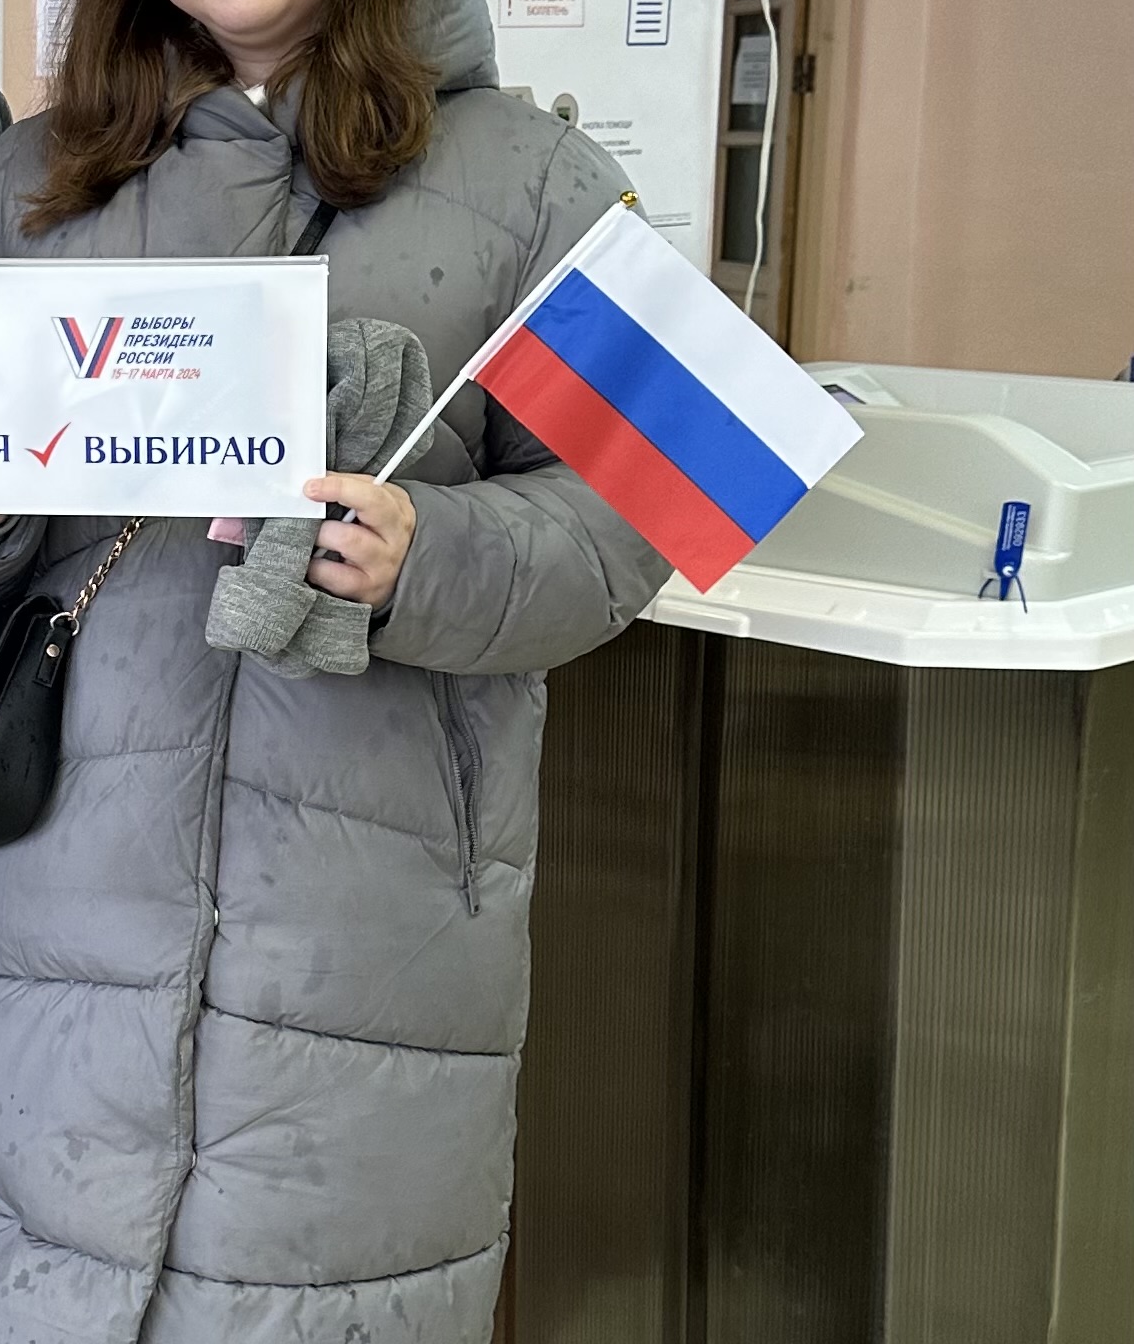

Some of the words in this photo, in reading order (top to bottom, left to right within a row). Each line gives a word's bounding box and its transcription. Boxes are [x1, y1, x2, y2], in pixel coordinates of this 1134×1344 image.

[131, 316, 195, 330] ВЫБОРЫ
[123, 333, 214, 349] ПРЕЗИДЕНТА
[116, 351, 174, 365] РОССИИ
[140, 368, 175, 380] МАРТА
[176, 368, 201, 380] 2024
[84, 435, 286, 466] ВЫБИРАЮ
